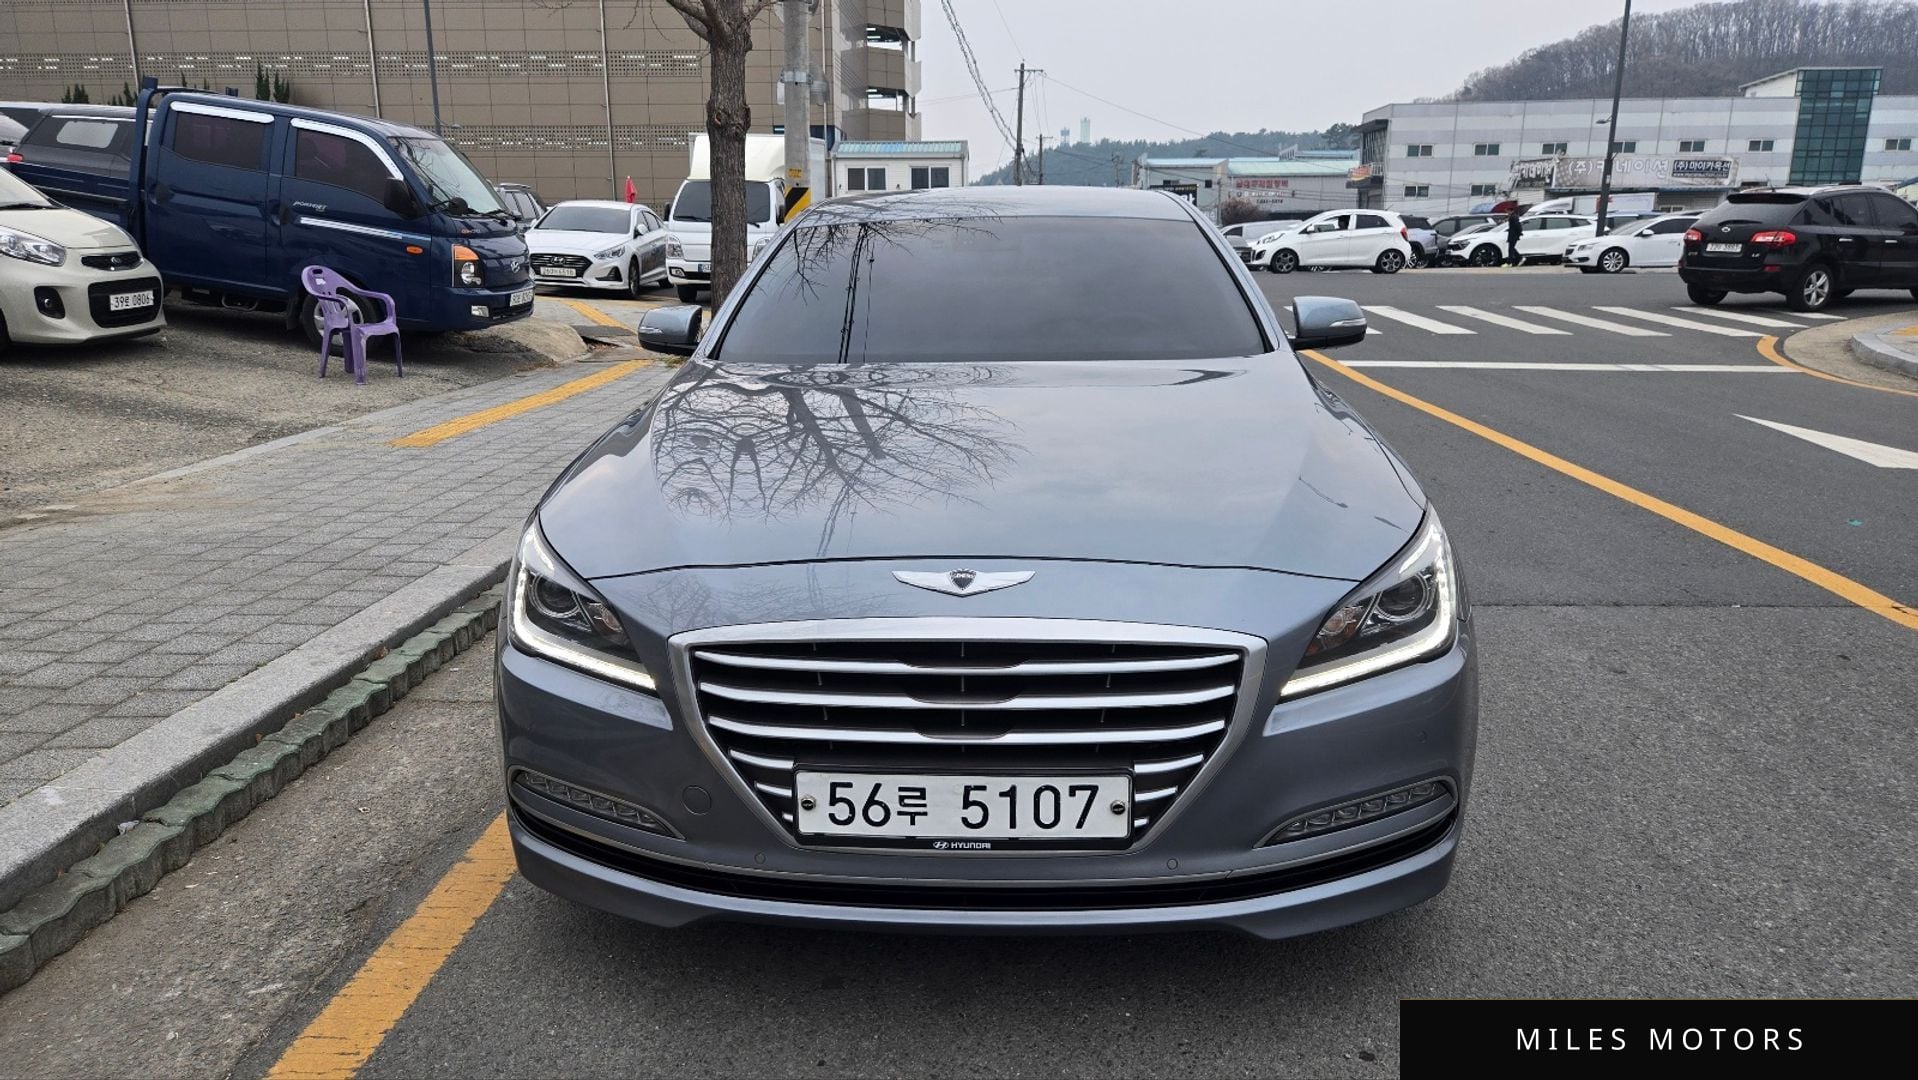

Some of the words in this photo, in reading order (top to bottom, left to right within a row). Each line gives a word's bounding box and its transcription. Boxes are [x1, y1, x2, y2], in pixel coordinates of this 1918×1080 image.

[828, 781, 929, 828] 56루
[961, 784, 1101, 831] 5107
[951, 842, 992, 850] HYUNDAI
